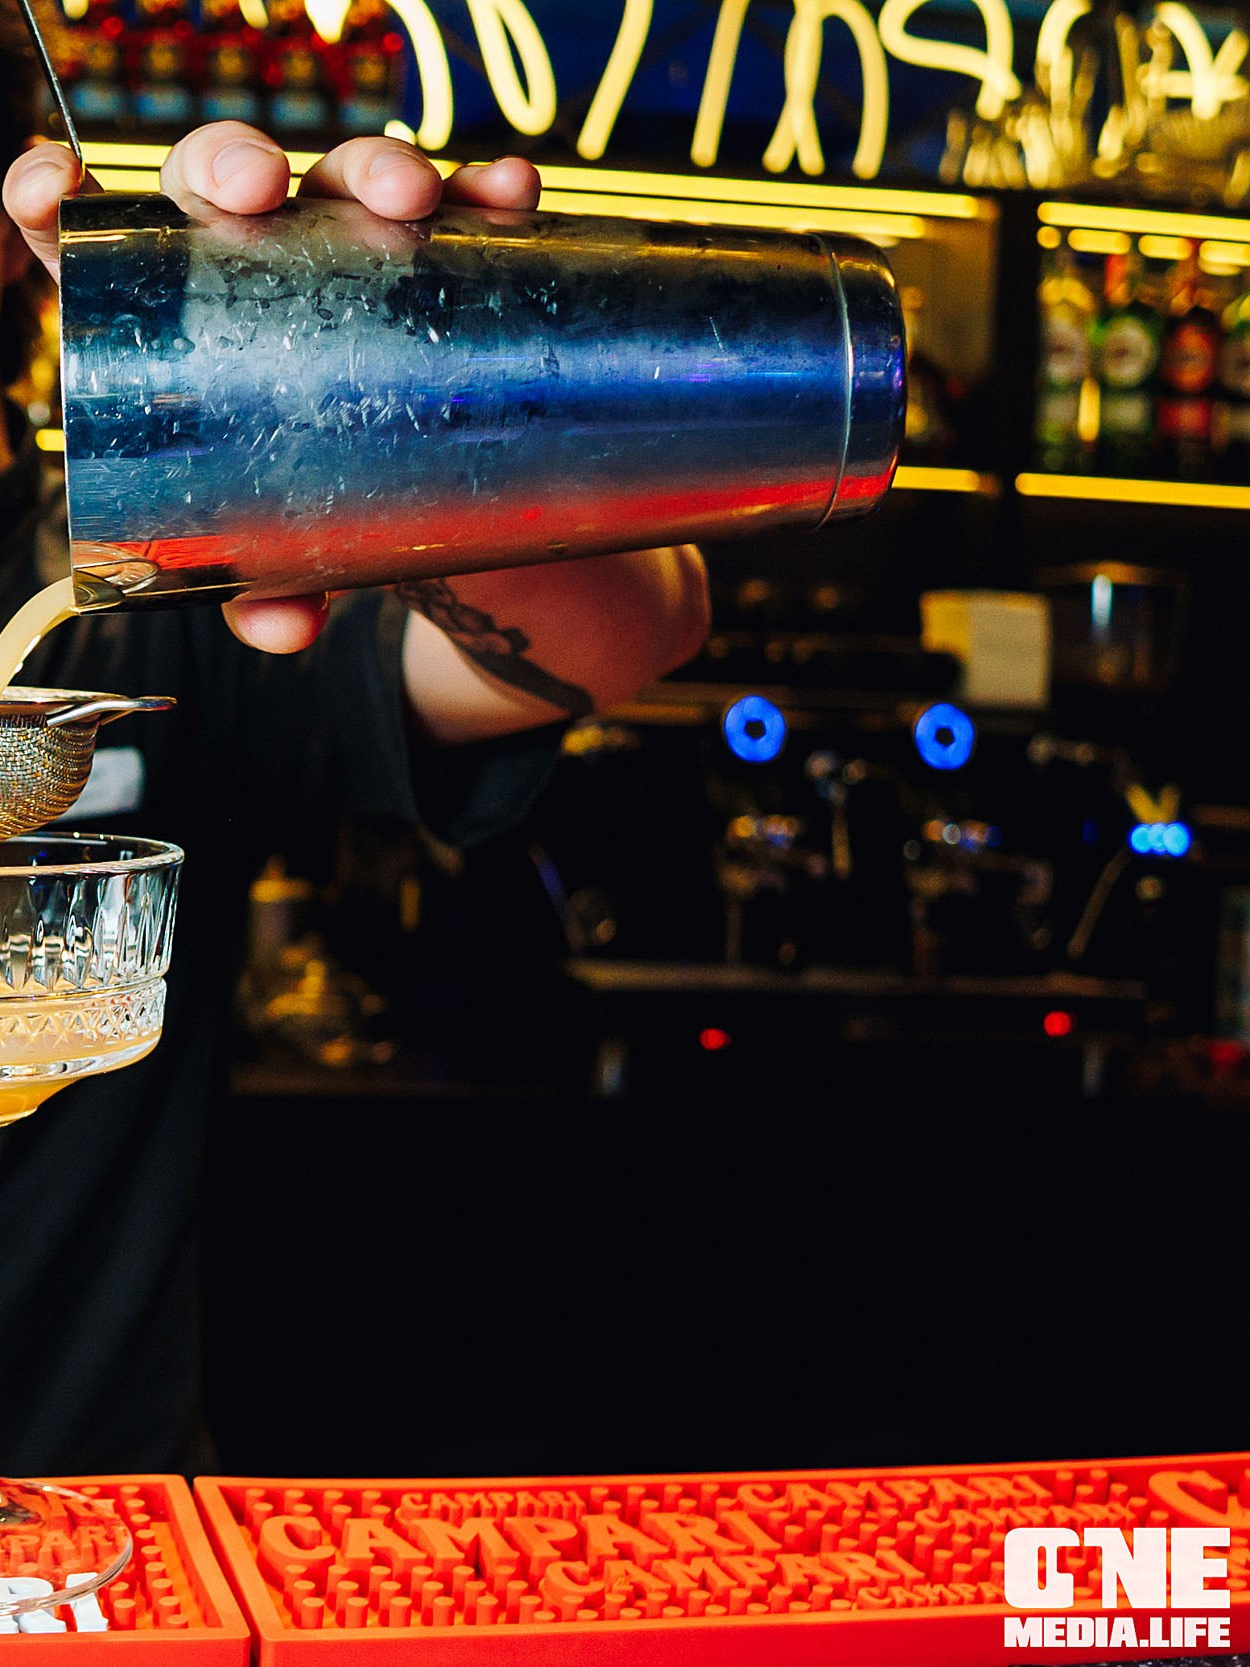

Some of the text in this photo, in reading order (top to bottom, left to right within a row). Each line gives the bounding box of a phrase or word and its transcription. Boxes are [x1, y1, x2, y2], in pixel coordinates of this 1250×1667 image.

[401, 1491, 582, 1510] CAMPARI
[737, 1475, 1052, 1508] CAMPARI
[915, 1503, 1137, 1528] CAMPARI
[260, 1511, 782, 1560] CAMPARI
[545, 1549, 925, 1594] CAMPARI
[856, 1580, 1006, 1605] CAMPA
